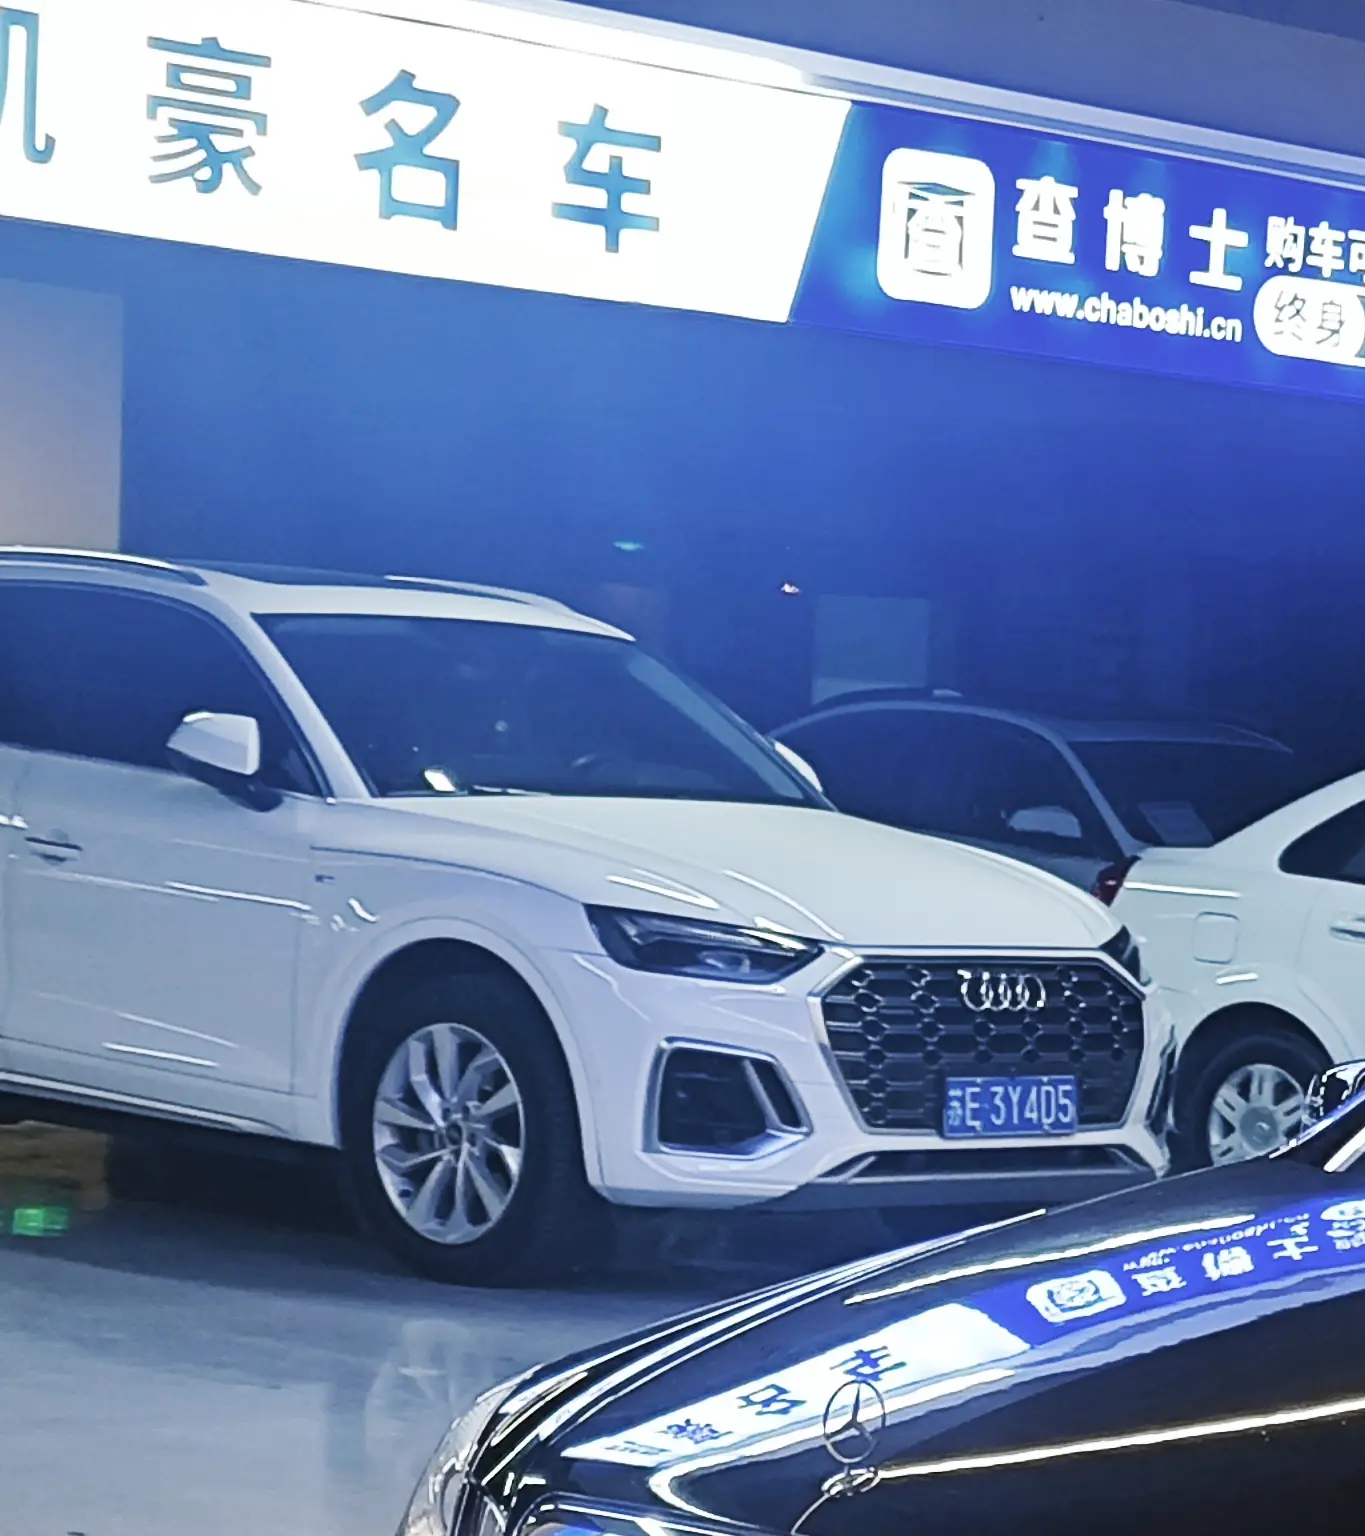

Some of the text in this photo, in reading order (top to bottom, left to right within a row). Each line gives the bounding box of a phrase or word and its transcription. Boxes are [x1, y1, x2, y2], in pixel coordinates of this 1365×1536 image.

[1011, 175, 1252, 292] 查博士
[1010, 283, 1244, 344] www.chaboshi.cn
[1271, 290, 1347, 349] 终身
